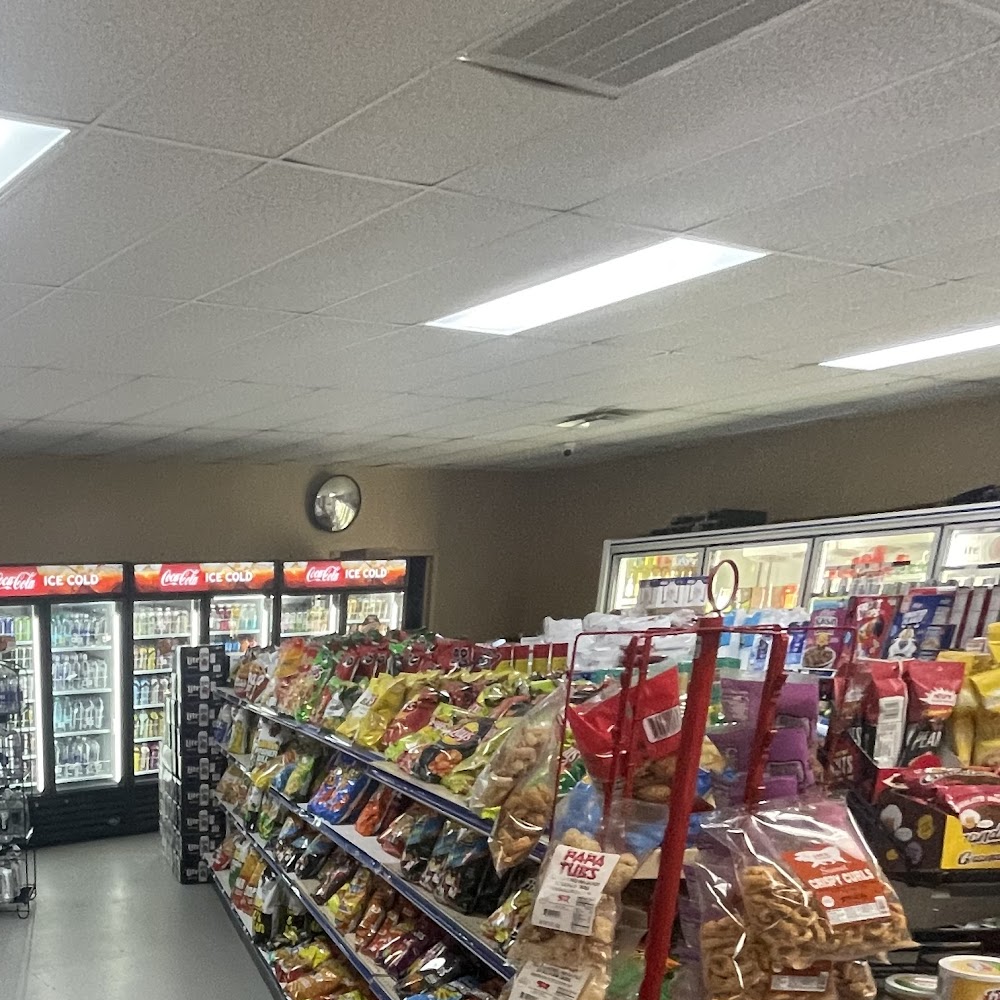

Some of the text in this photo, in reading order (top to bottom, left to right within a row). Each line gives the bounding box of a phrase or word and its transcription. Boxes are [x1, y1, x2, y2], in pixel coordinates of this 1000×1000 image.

[43, 573, 99, 588] ICE COLD
[160, 569, 199, 588] Coca-Cola
[204, 570, 253, 584] ICE COLD
[306, 565, 340, 584] Coca-Cola
[345, 567, 388, 580] ICE COLD
[808, 868, 875, 889] CRISPY CURLS
